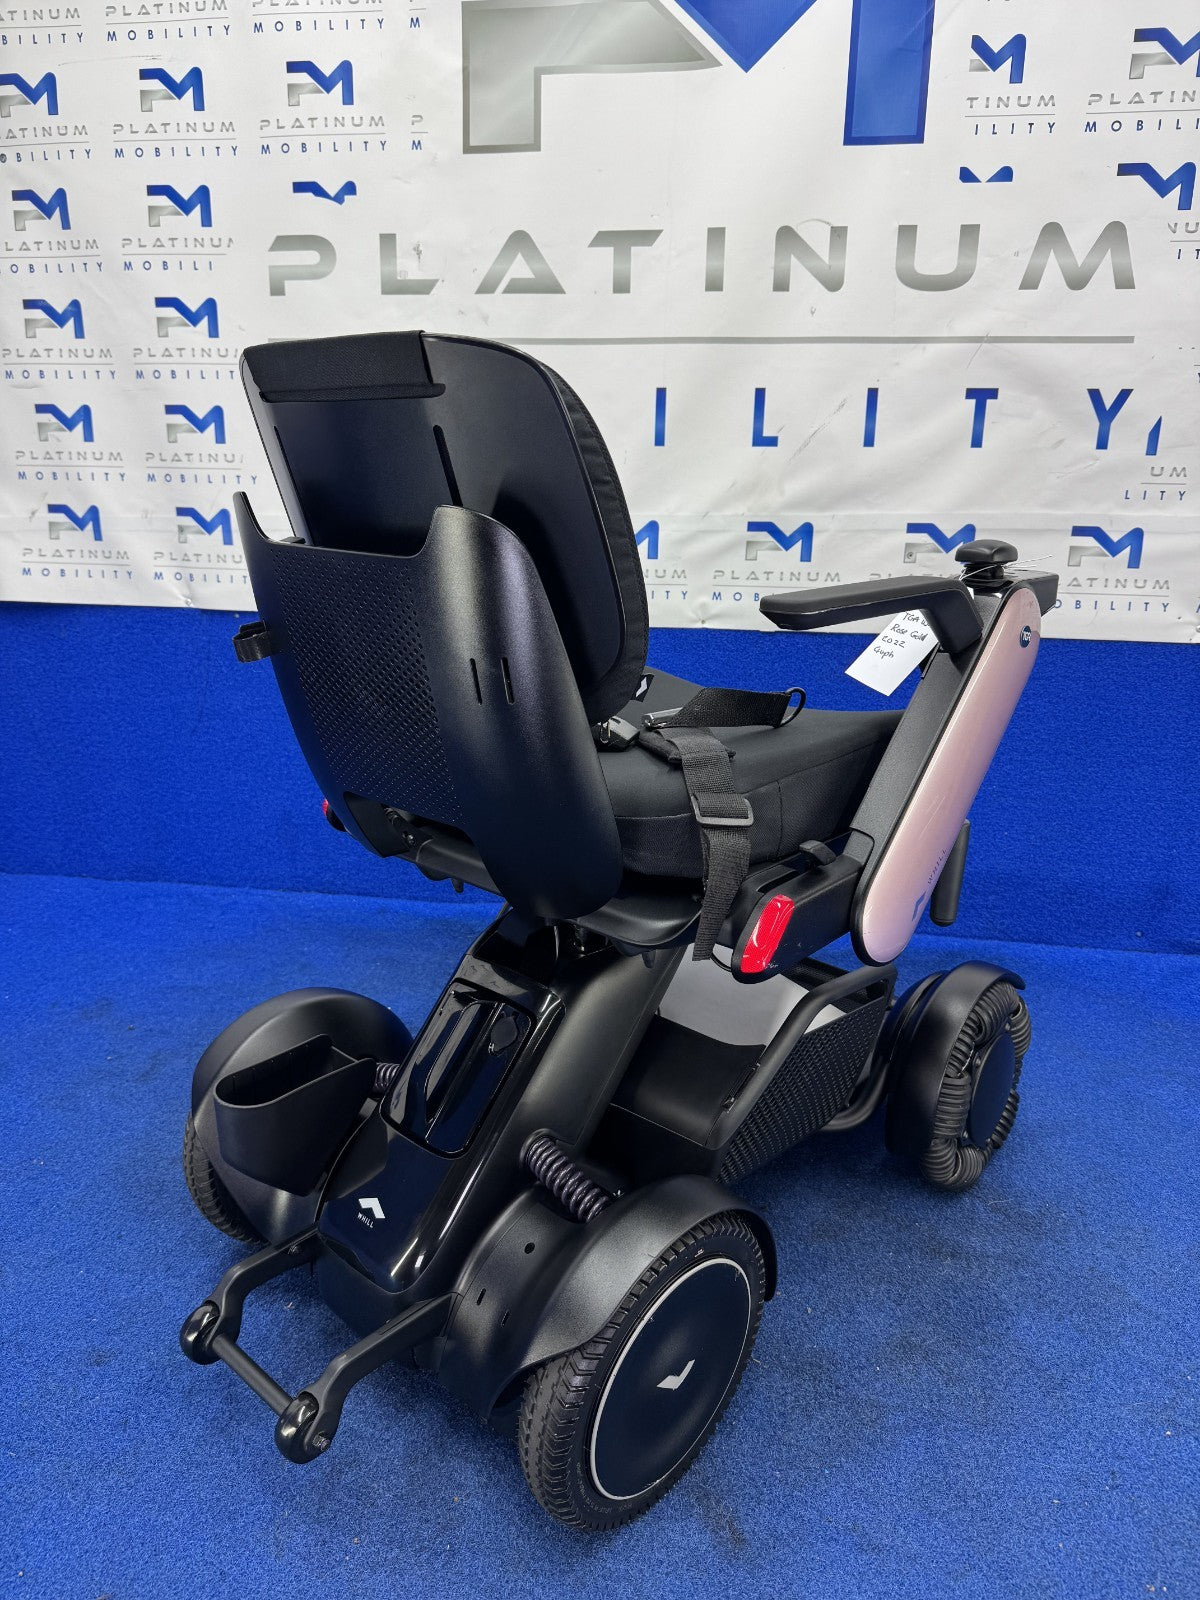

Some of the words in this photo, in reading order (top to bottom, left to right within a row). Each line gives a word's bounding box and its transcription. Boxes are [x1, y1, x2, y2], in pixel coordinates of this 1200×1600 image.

[105, 0, 228, 16] PLATINUM
[253, 18, 384, 33] MOBILITY
[2, 33, 83, 45] BILITY
[107, 25, 230, 41] MOBILITY
[1088, 90, 1197, 105] PLATIN
[113, 121, 235, 134] PLATINUM
[259, 116, 385, 130] PLATINUM
[114, 145, 238, 159] MOBILITY
[261, 140, 387, 155] MOBILITY
[5, 239, 99, 251] LATINUM
[268, 221, 1136, 297] PLATINUM
[124, 260, 212, 271] MOBILI
[2, 348, 112, 358] PLATINUM
[5, 369, 116, 380] MOBILITY
[136, 369, 234, 380] MOBILIT
[15, 450, 123, 461] PLATINUM
[145, 452, 243, 463] PLATINU
[18, 471, 125, 482] MOBILITY
[148, 473, 257, 485] MOBILITY
[22, 547, 130, 560] PLATINUM
[22, 567, 133, 579] MOBILITY
[713, 569, 841, 582] PLATINUM
[882, 636, 905, 648] 2022
[357, 1211, 374, 1229] WHILL
